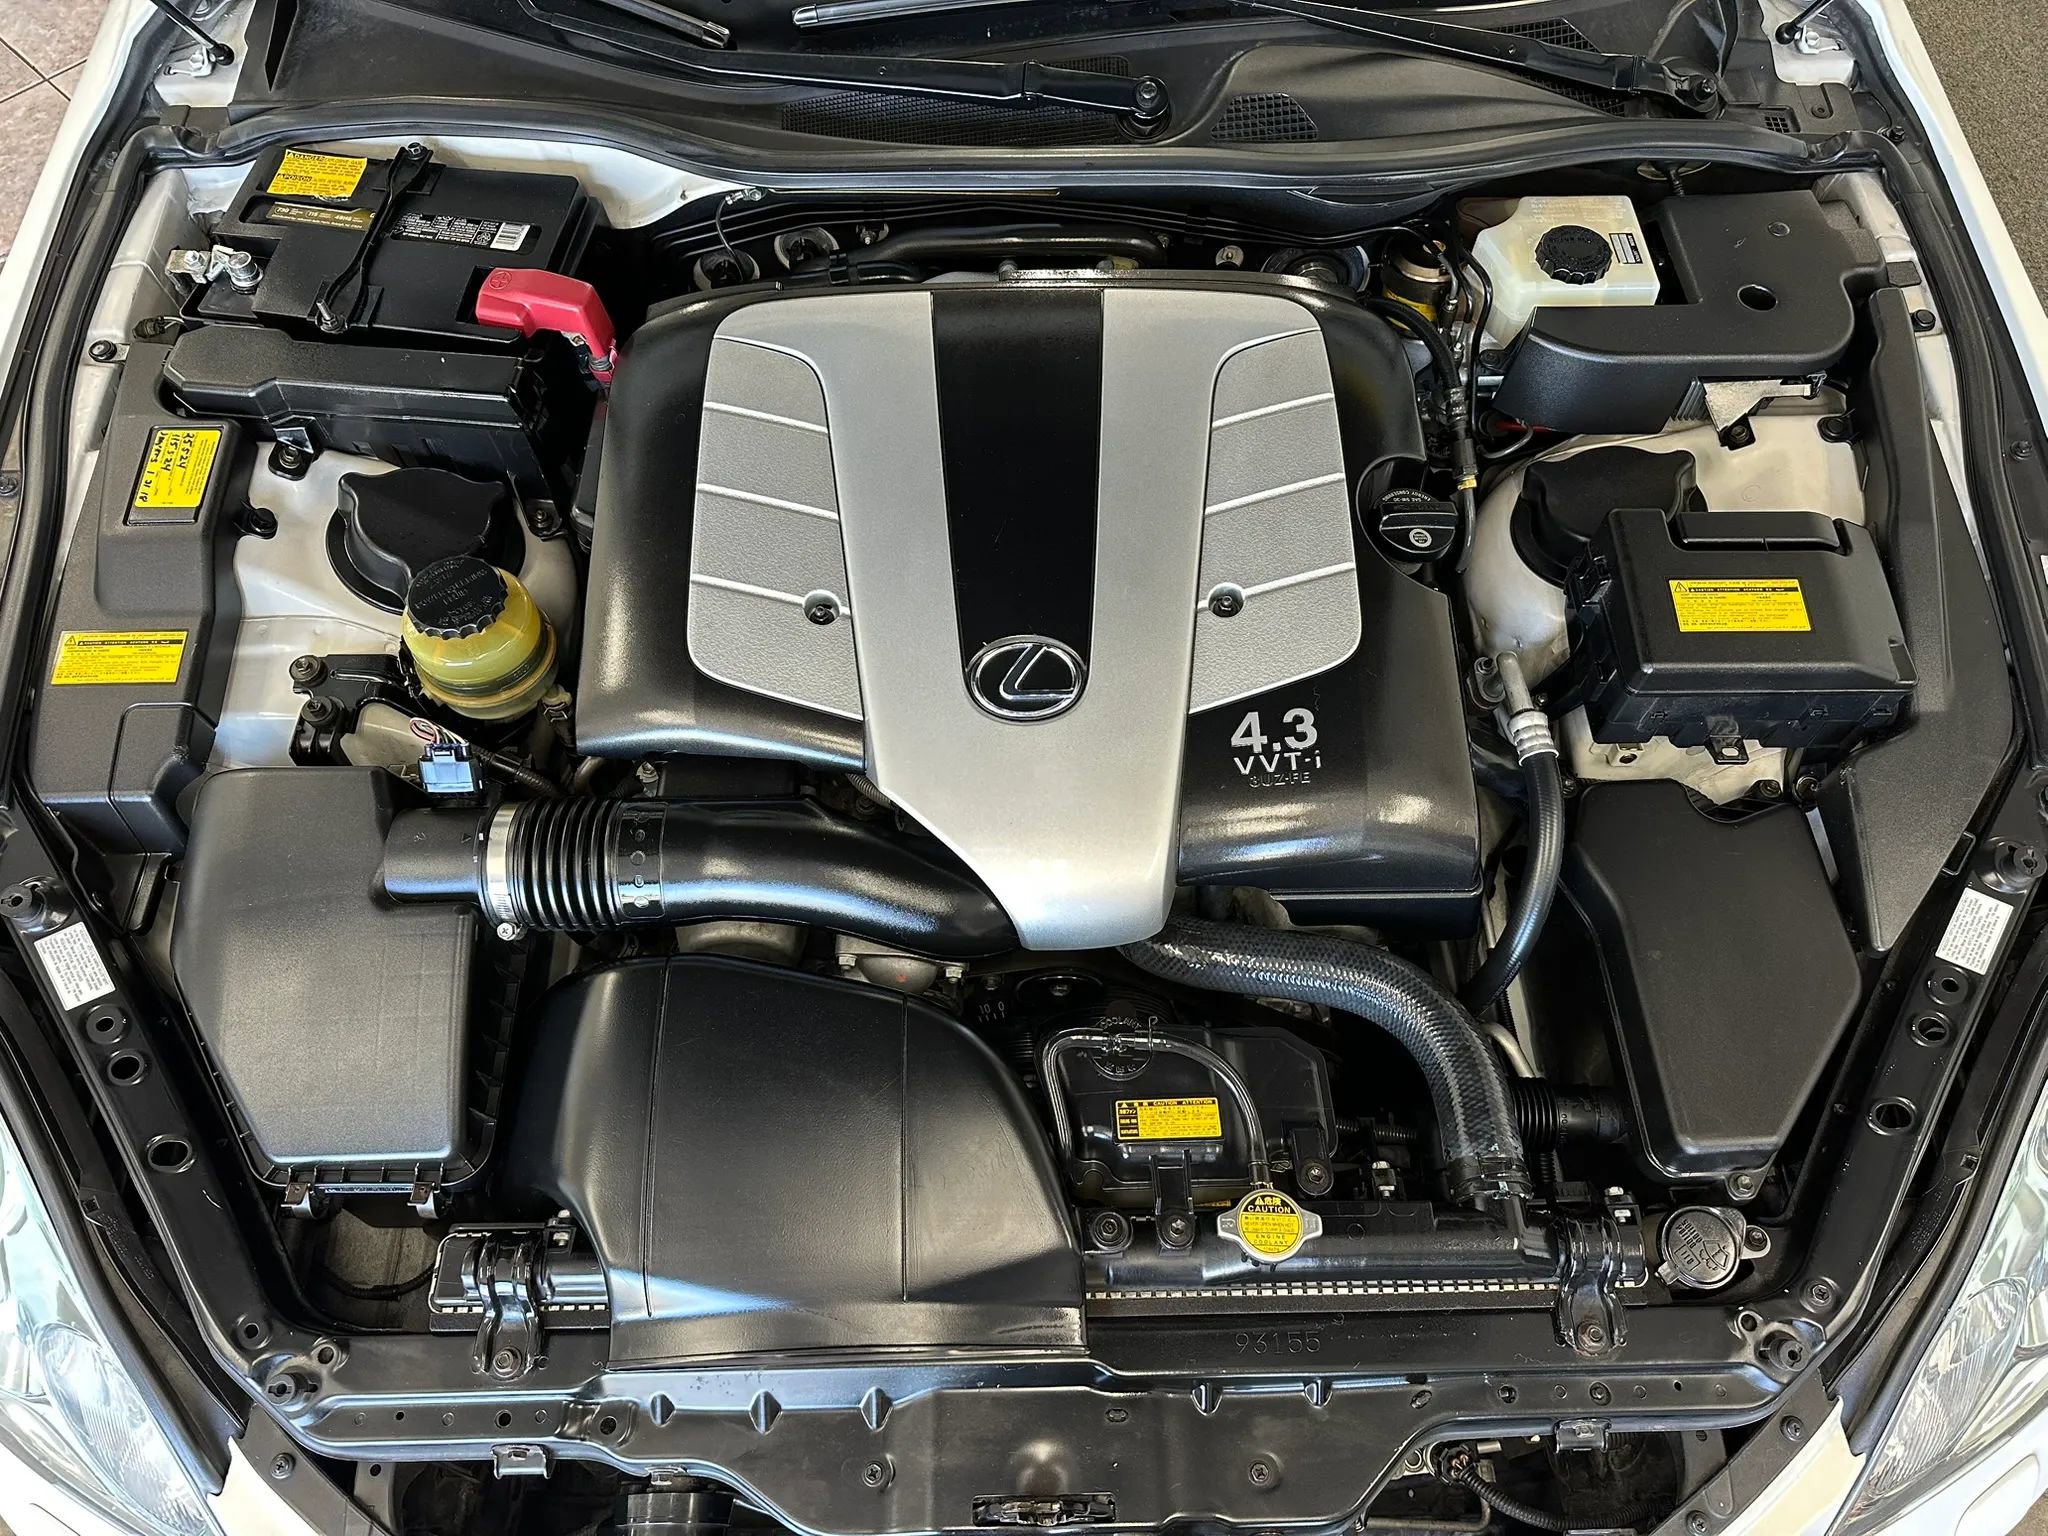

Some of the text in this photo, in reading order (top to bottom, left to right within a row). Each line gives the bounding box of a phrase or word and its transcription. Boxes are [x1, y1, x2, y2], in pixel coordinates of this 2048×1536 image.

[1230, 708, 1318, 754] 4.3
[1233, 750, 1322, 775] VVT-i
[1247, 1205, 1291, 1214] CAUTION
[1235, 1329, 1321, 1355] 93155
